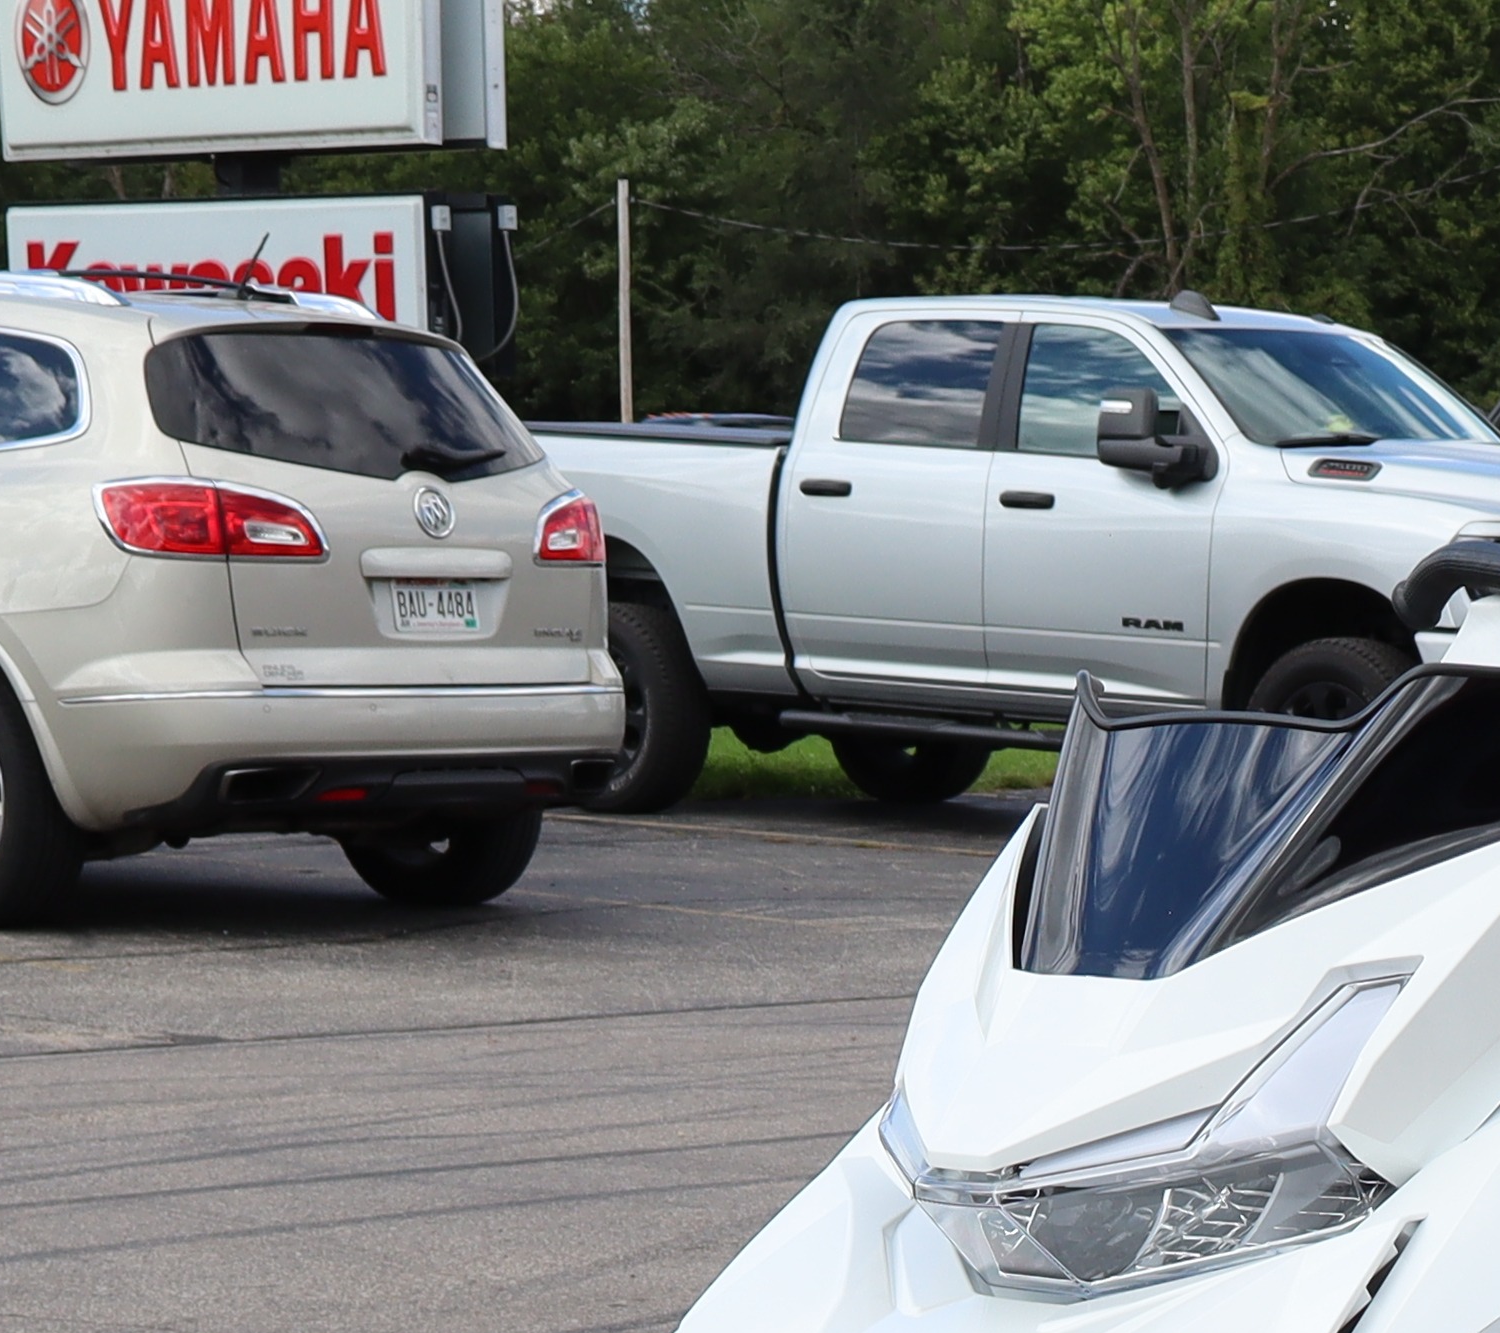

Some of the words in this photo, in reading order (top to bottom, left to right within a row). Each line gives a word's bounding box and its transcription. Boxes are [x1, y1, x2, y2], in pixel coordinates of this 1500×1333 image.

[99, 0, 387, 91] YAMAHA
[396, 590, 475, 619] BAU-4484
[1121, 616, 1184, 632] RAM
